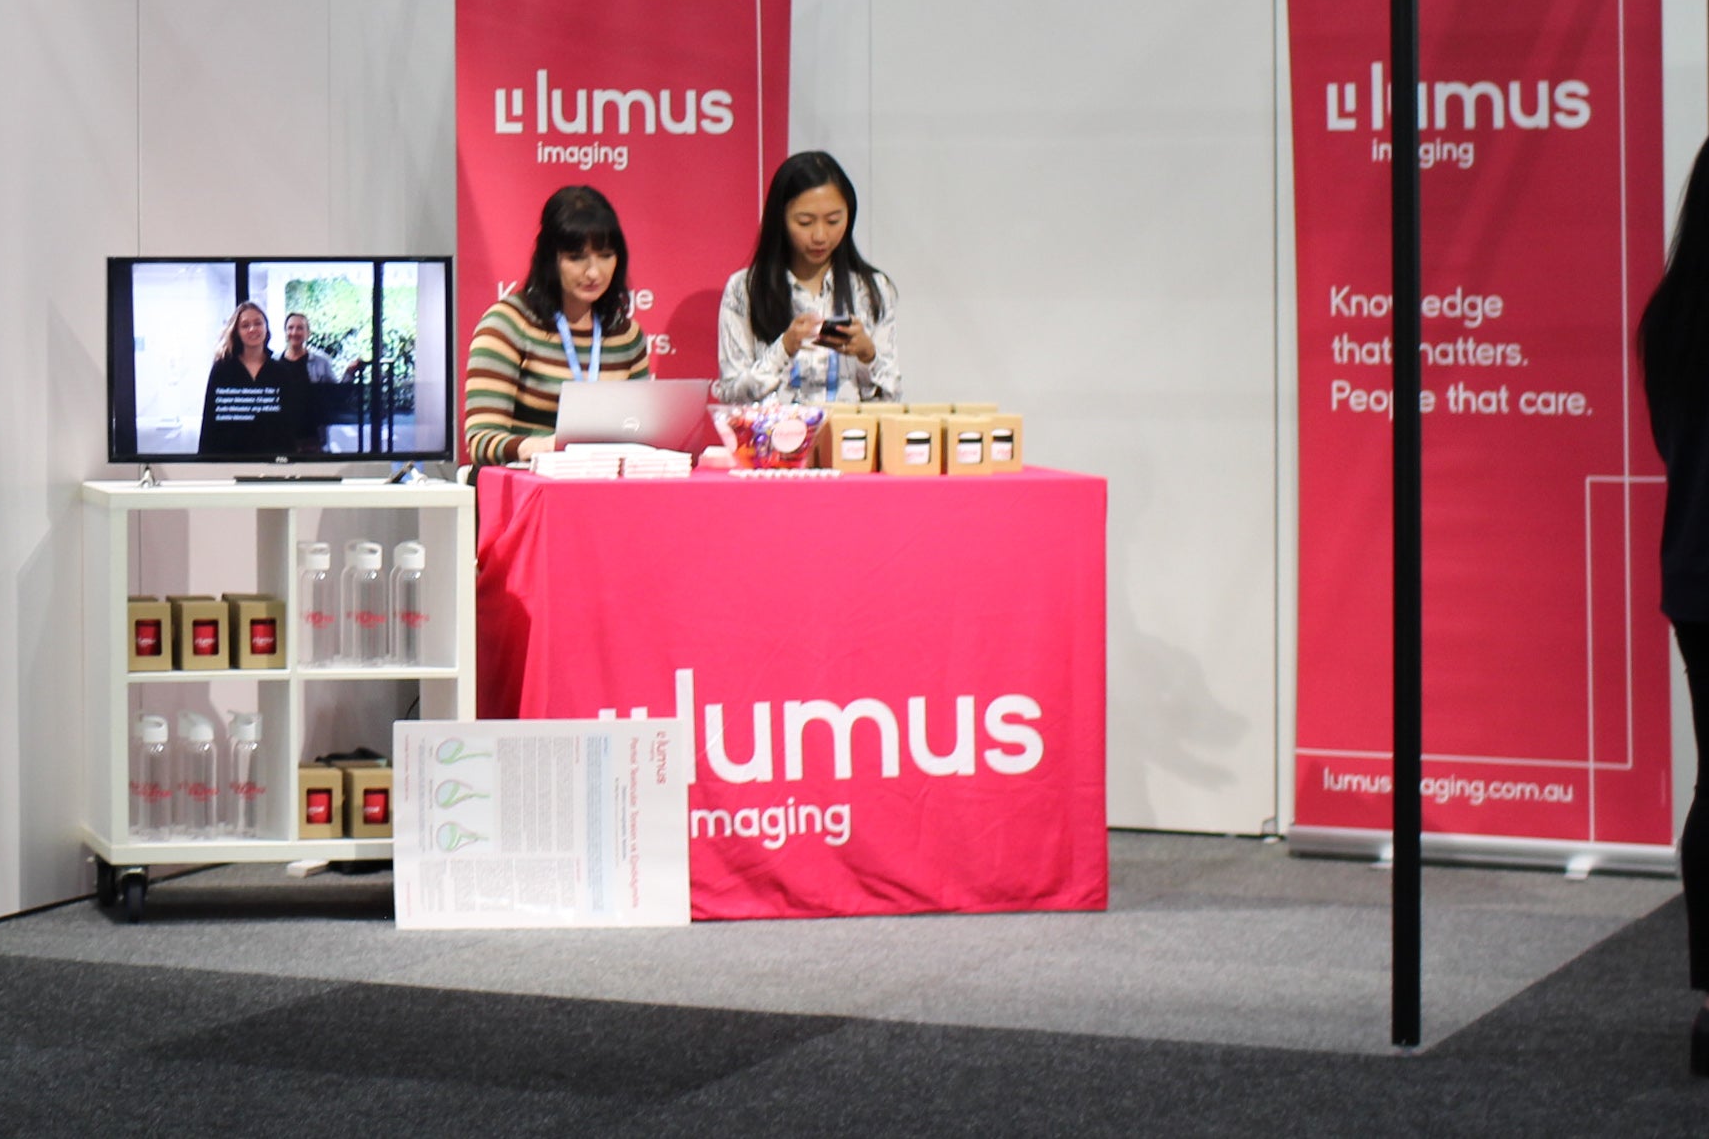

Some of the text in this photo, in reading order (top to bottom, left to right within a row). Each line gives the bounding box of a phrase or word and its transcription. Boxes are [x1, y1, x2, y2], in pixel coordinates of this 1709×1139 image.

[537, 69, 735, 135] lumus
[537, 141, 629, 171] imaging
[1372, 138, 1475, 169] imging
[1330, 285, 1504, 328] Knoedge
[1332, 333, 1393, 366] that
[1331, 379, 1594, 422] Peoe that care.
[675, 668, 1046, 785] lumus
[1323, 766, 1575, 805] lumusaging.com.au
[691, 797, 852, 850] maging
